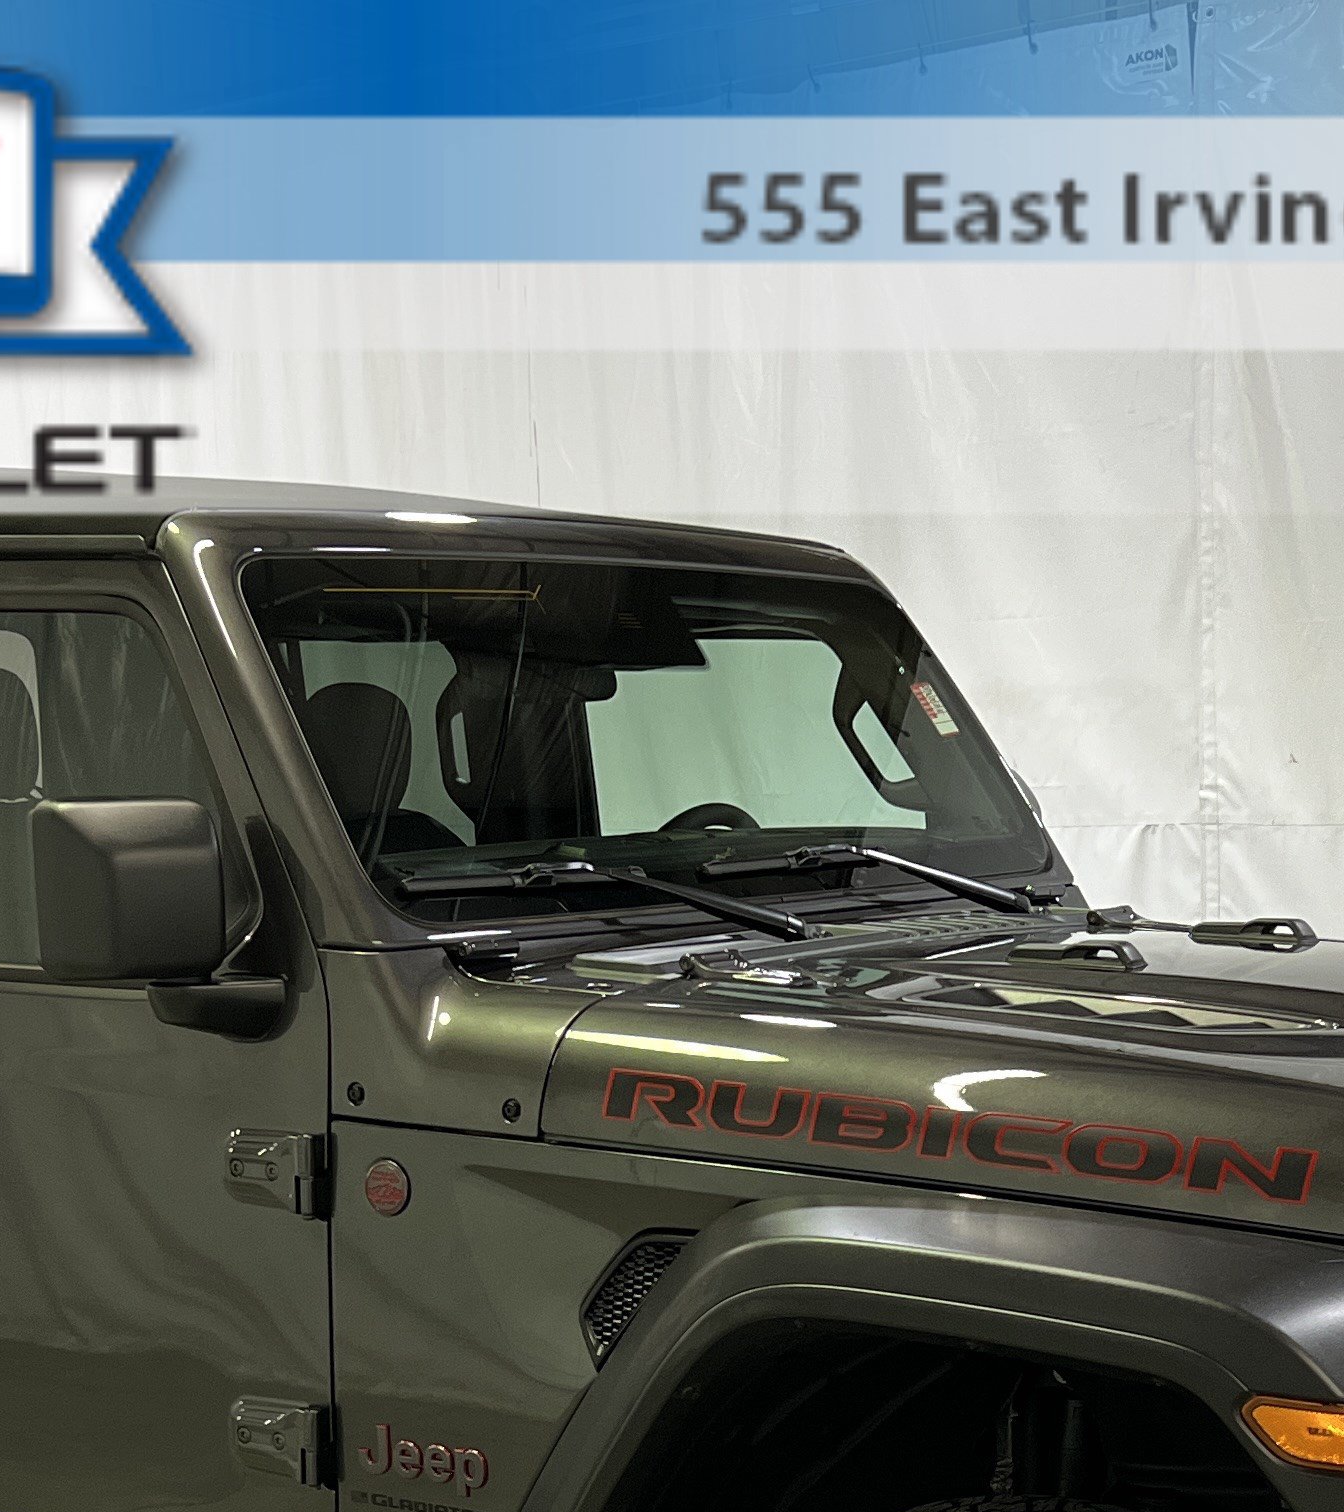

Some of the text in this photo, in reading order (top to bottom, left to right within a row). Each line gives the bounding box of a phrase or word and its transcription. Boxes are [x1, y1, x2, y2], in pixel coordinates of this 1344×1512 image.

[1125, 47, 1164, 67] AKON
[602, 1066, 1320, 1206] RUBICON
[358, 1423, 490, 1498] Jeep
